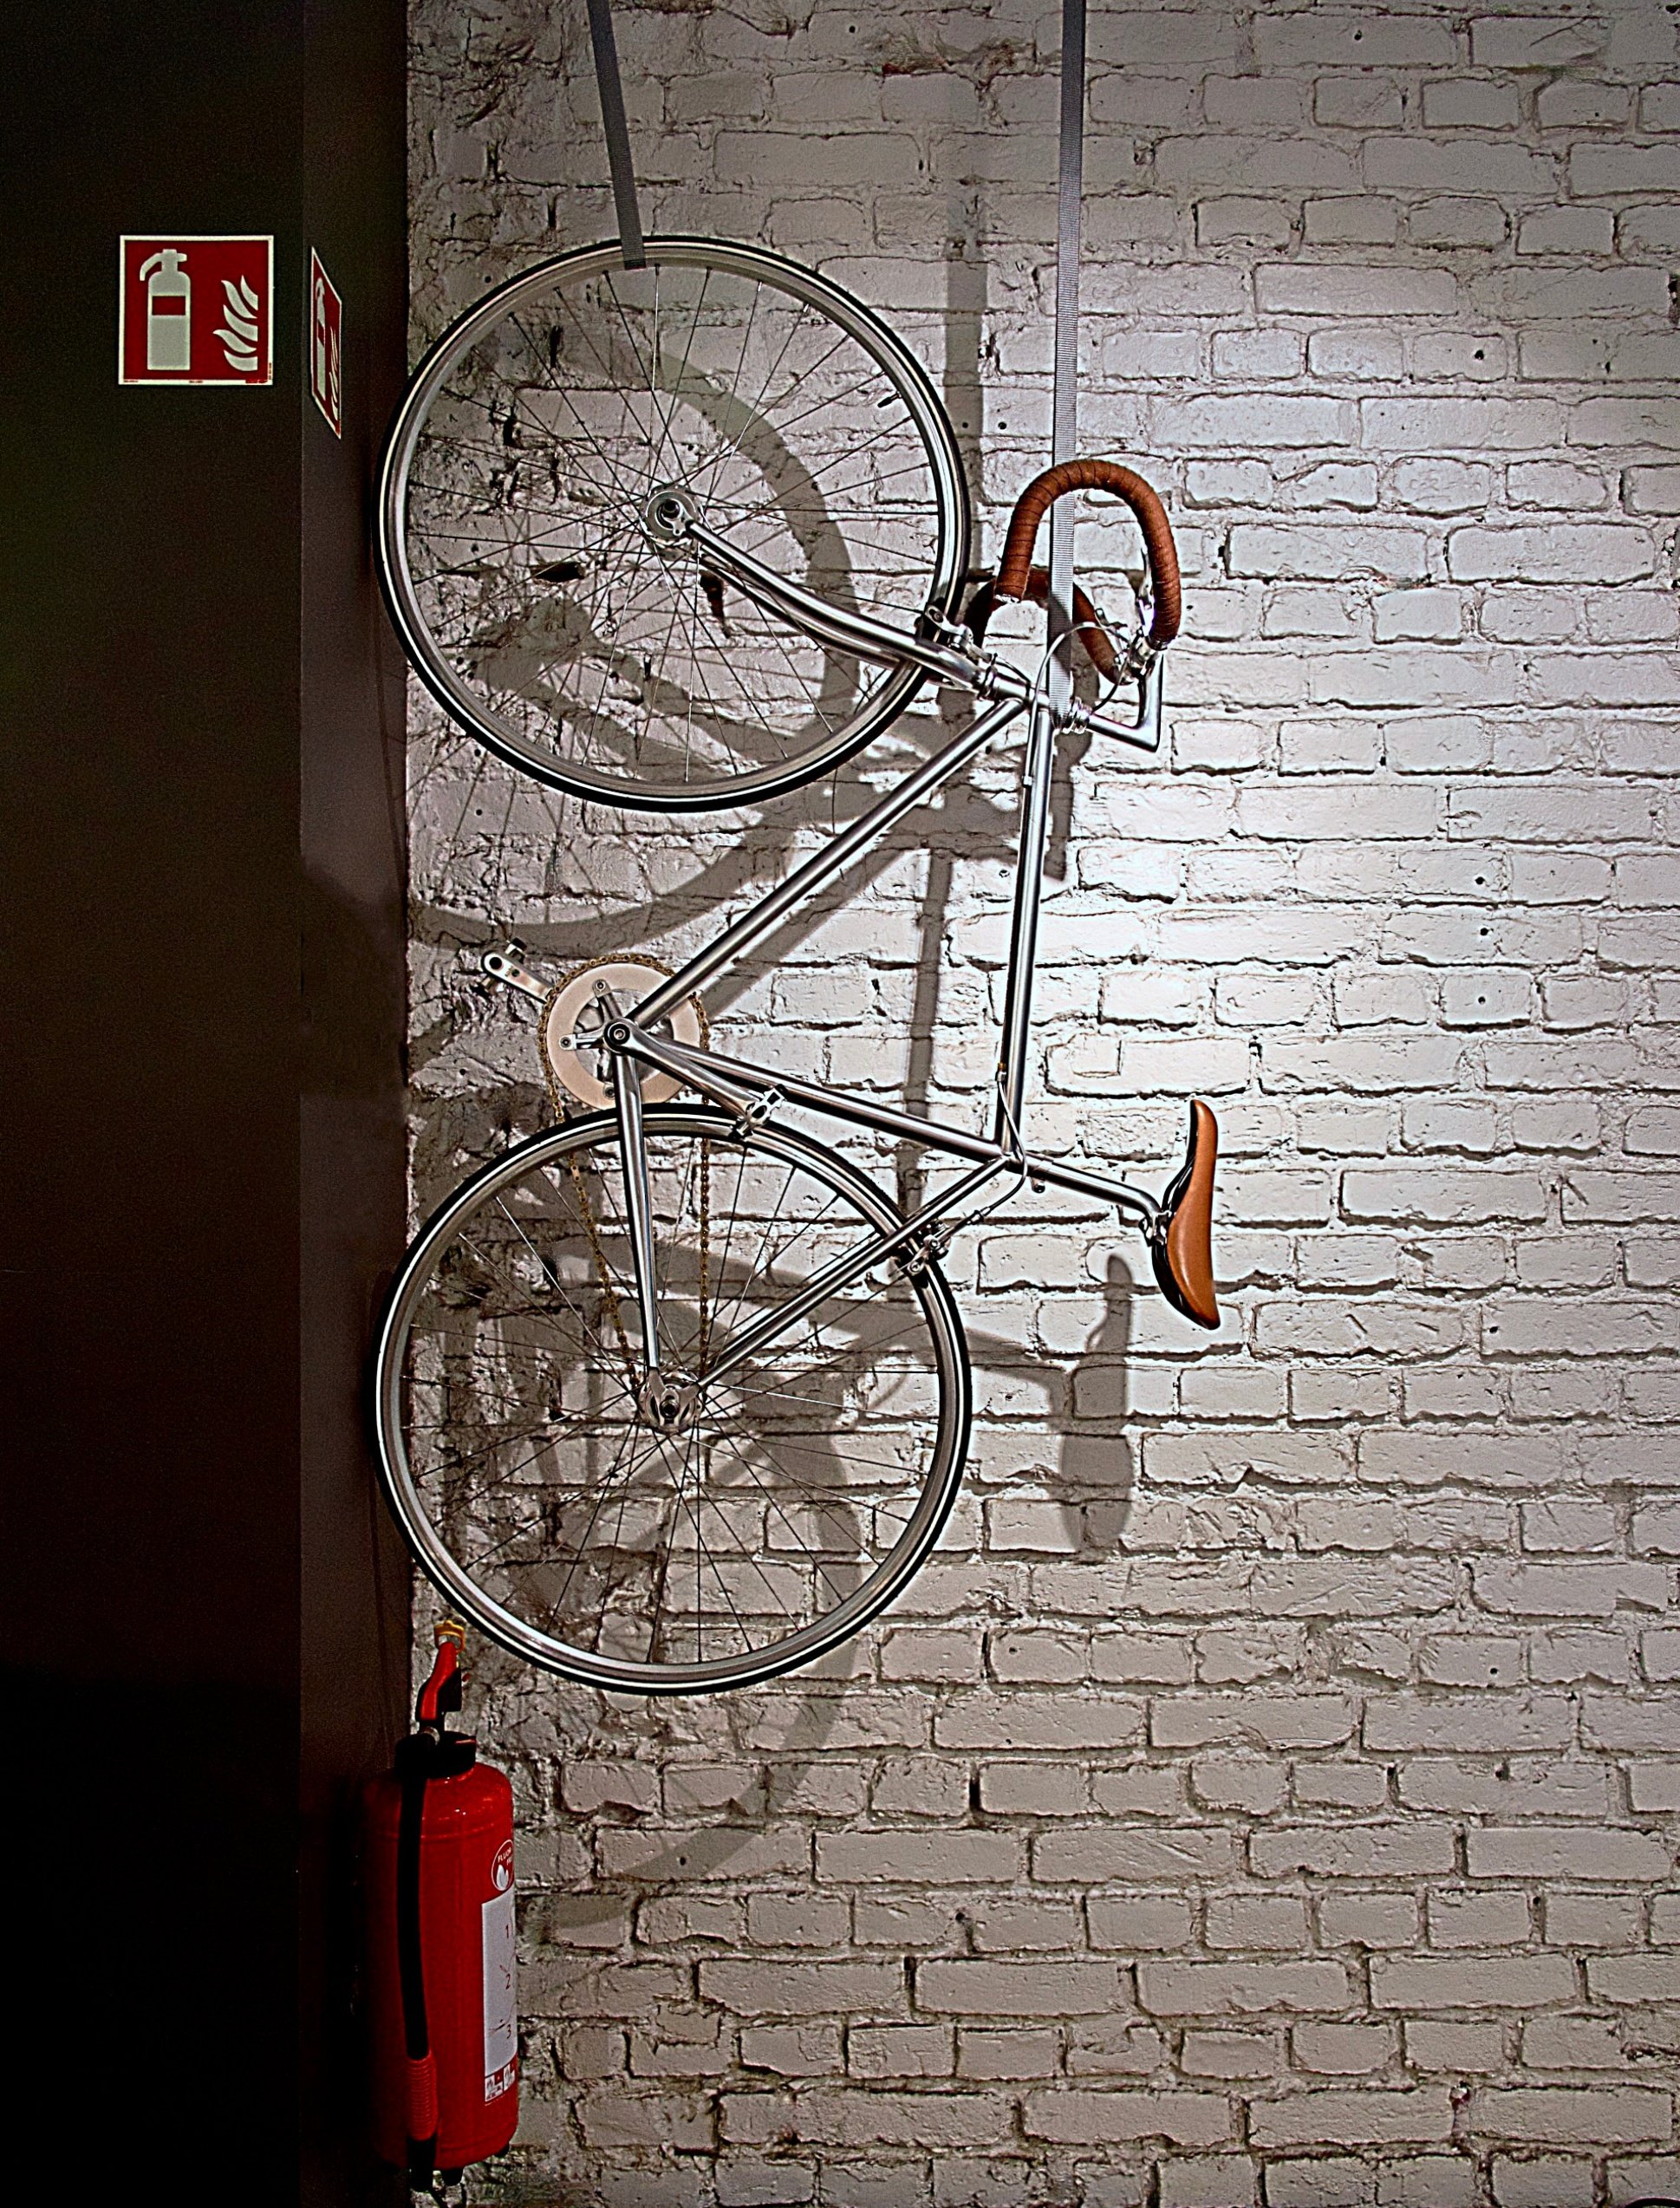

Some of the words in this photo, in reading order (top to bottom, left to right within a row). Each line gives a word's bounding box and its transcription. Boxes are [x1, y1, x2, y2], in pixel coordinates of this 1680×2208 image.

[505, 1924, 510, 1939] 1
[505, 1973, 511, 1990] 2
[506, 2024, 511, 2039] 3
